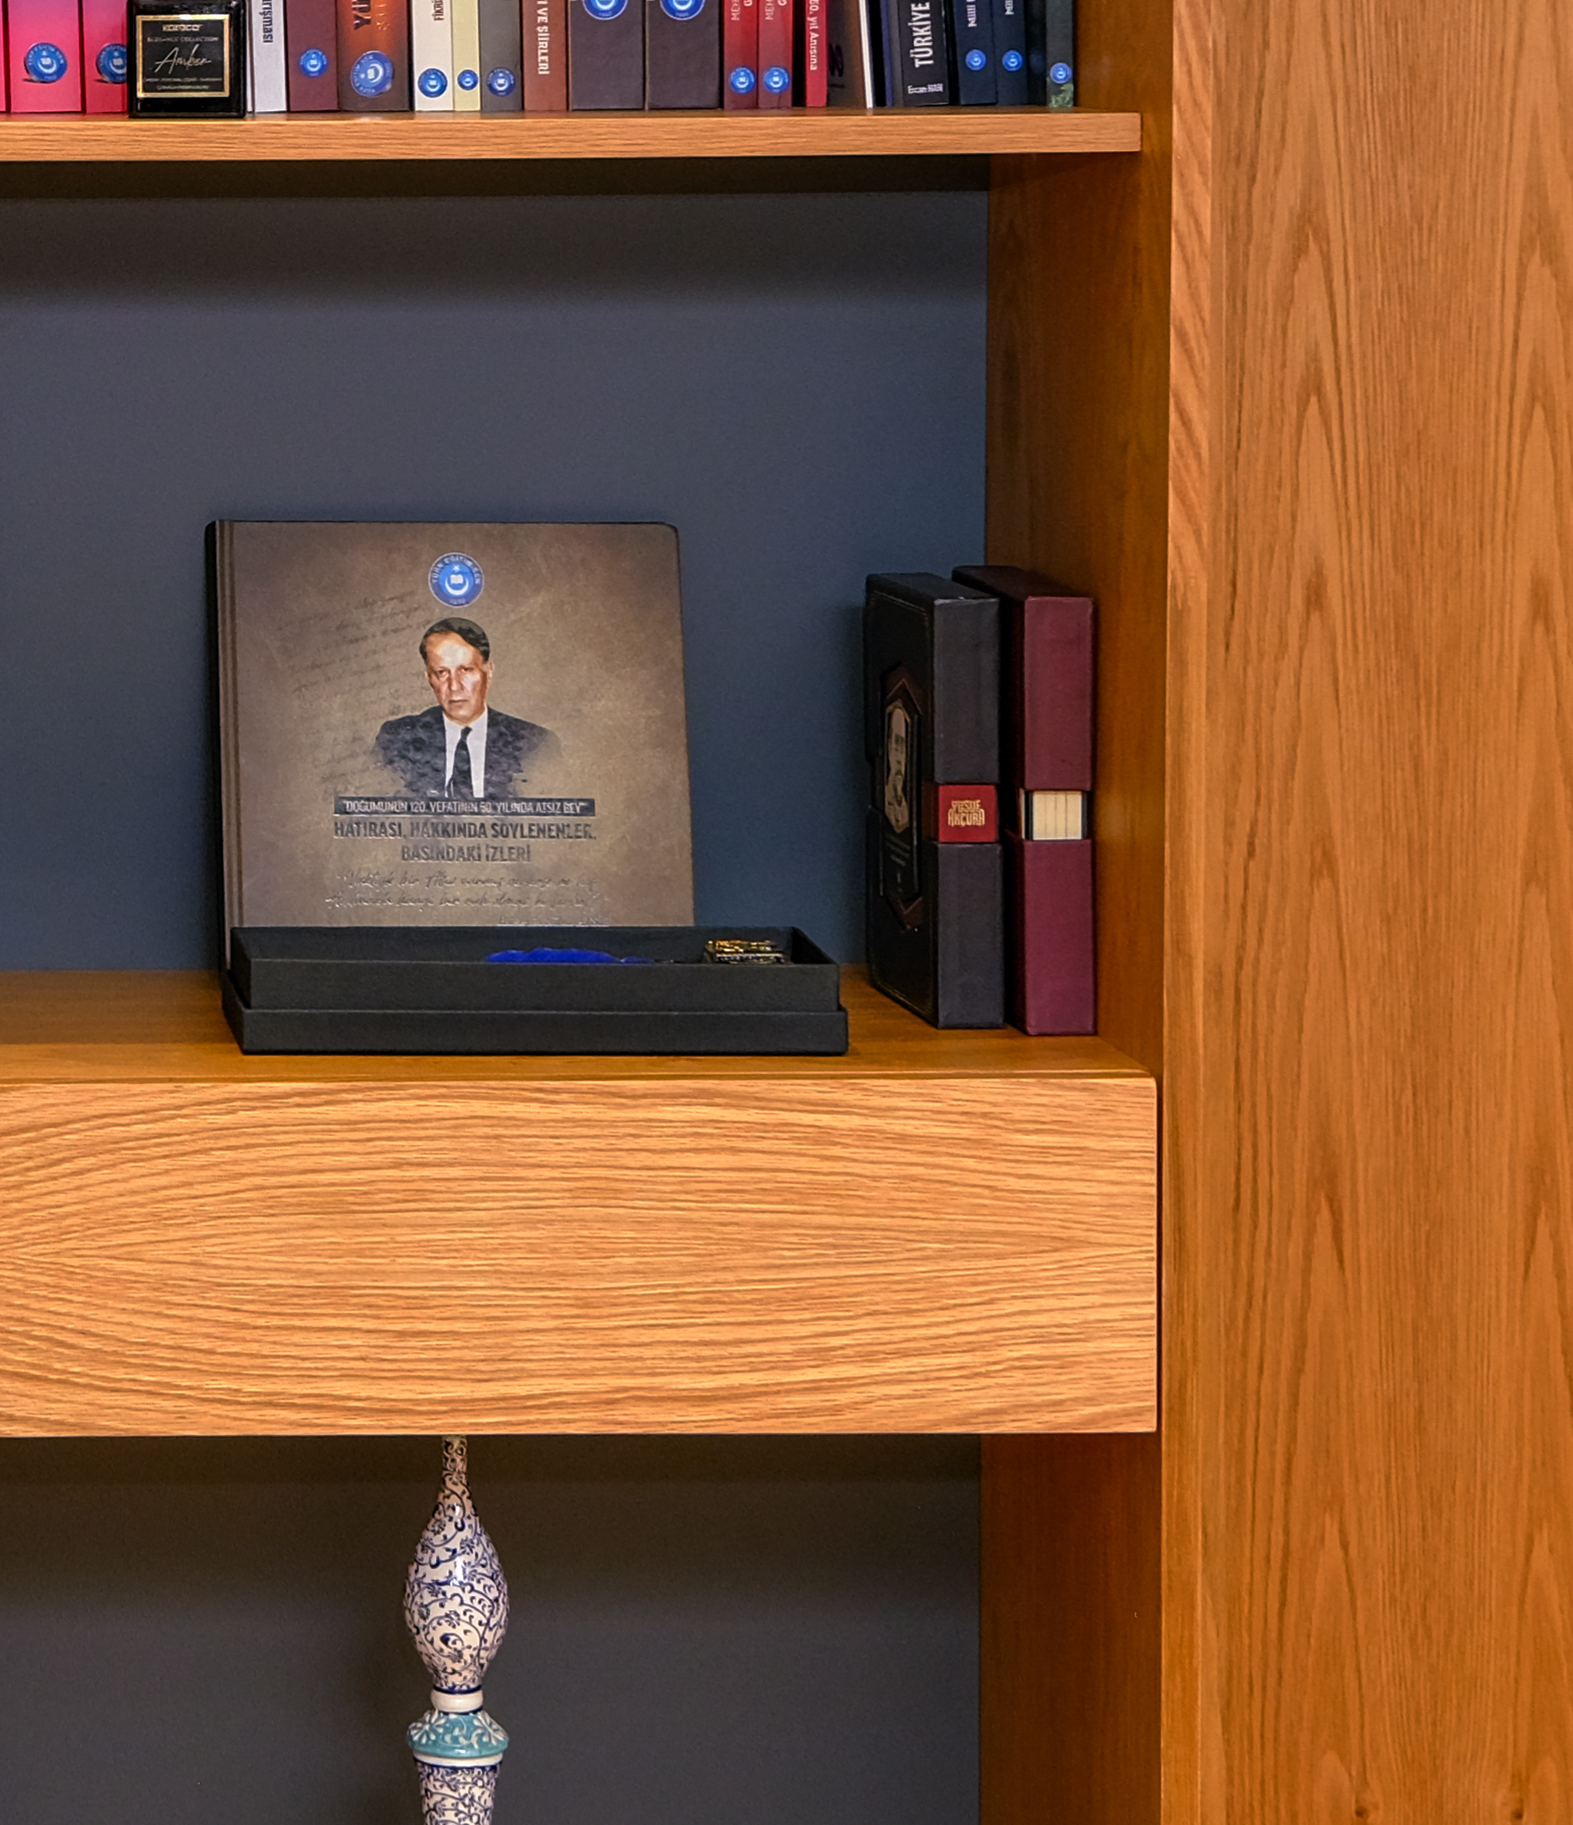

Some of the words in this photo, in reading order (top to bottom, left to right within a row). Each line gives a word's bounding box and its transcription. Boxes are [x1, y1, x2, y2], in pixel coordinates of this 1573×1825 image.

[537, 8, 548, 23] VE
[908, 3, 934, 68] TÜRKİYE
[154, 44, 212, 74] Amber
[536, 26, 551, 74] ŞİİRLERİ
[334, 822, 406, 839] HATIRASI,
[410, 822, 487, 838] HAKKINDA
[401, 844, 480, 862] BASINDAKİ
[485, 843, 529, 861] İZLERİ
